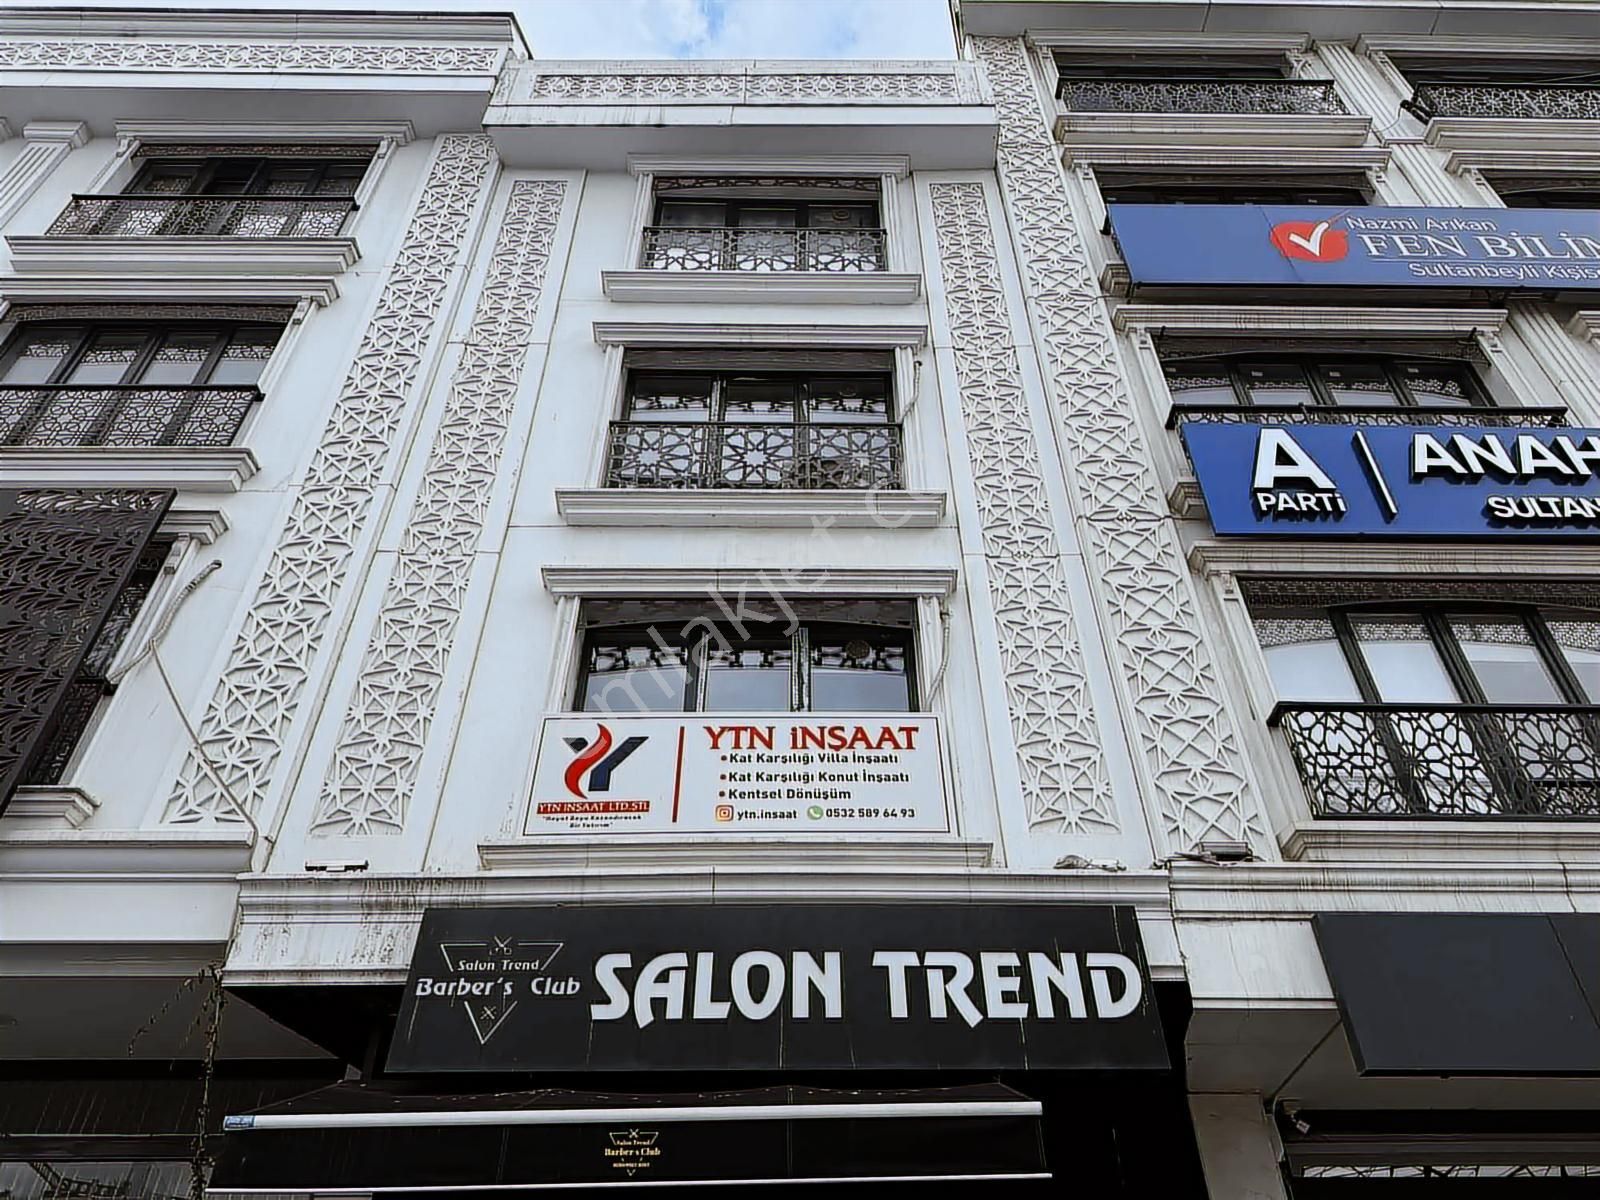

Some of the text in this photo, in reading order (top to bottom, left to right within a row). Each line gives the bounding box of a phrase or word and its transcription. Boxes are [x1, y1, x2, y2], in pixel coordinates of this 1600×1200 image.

[1346, 216, 1498, 232] Nazmi Arıkan
[1357, 233, 1469, 258] FEN
[1408, 262, 1600, 281] Sultanbeyli Kişis
[1253, 427, 1338, 489] A
[702, 725, 776, 750] YTN
[729, 750, 899, 766] Kat Karşılığı Villa İnşaatı
[728, 769, 909, 784] Kat Karşılığı Konut İnşaatı
[728, 787, 852, 801] Kentsel Dönüşüm
[737, 808, 798, 821] ytn.insaat
[825, 807, 916, 819] 0532 589 64 93
[457, 959, 540, 972] Salon Trend
[530, 976, 581, 995] Club
[590, 950, 1143, 1029] SALON TREND
